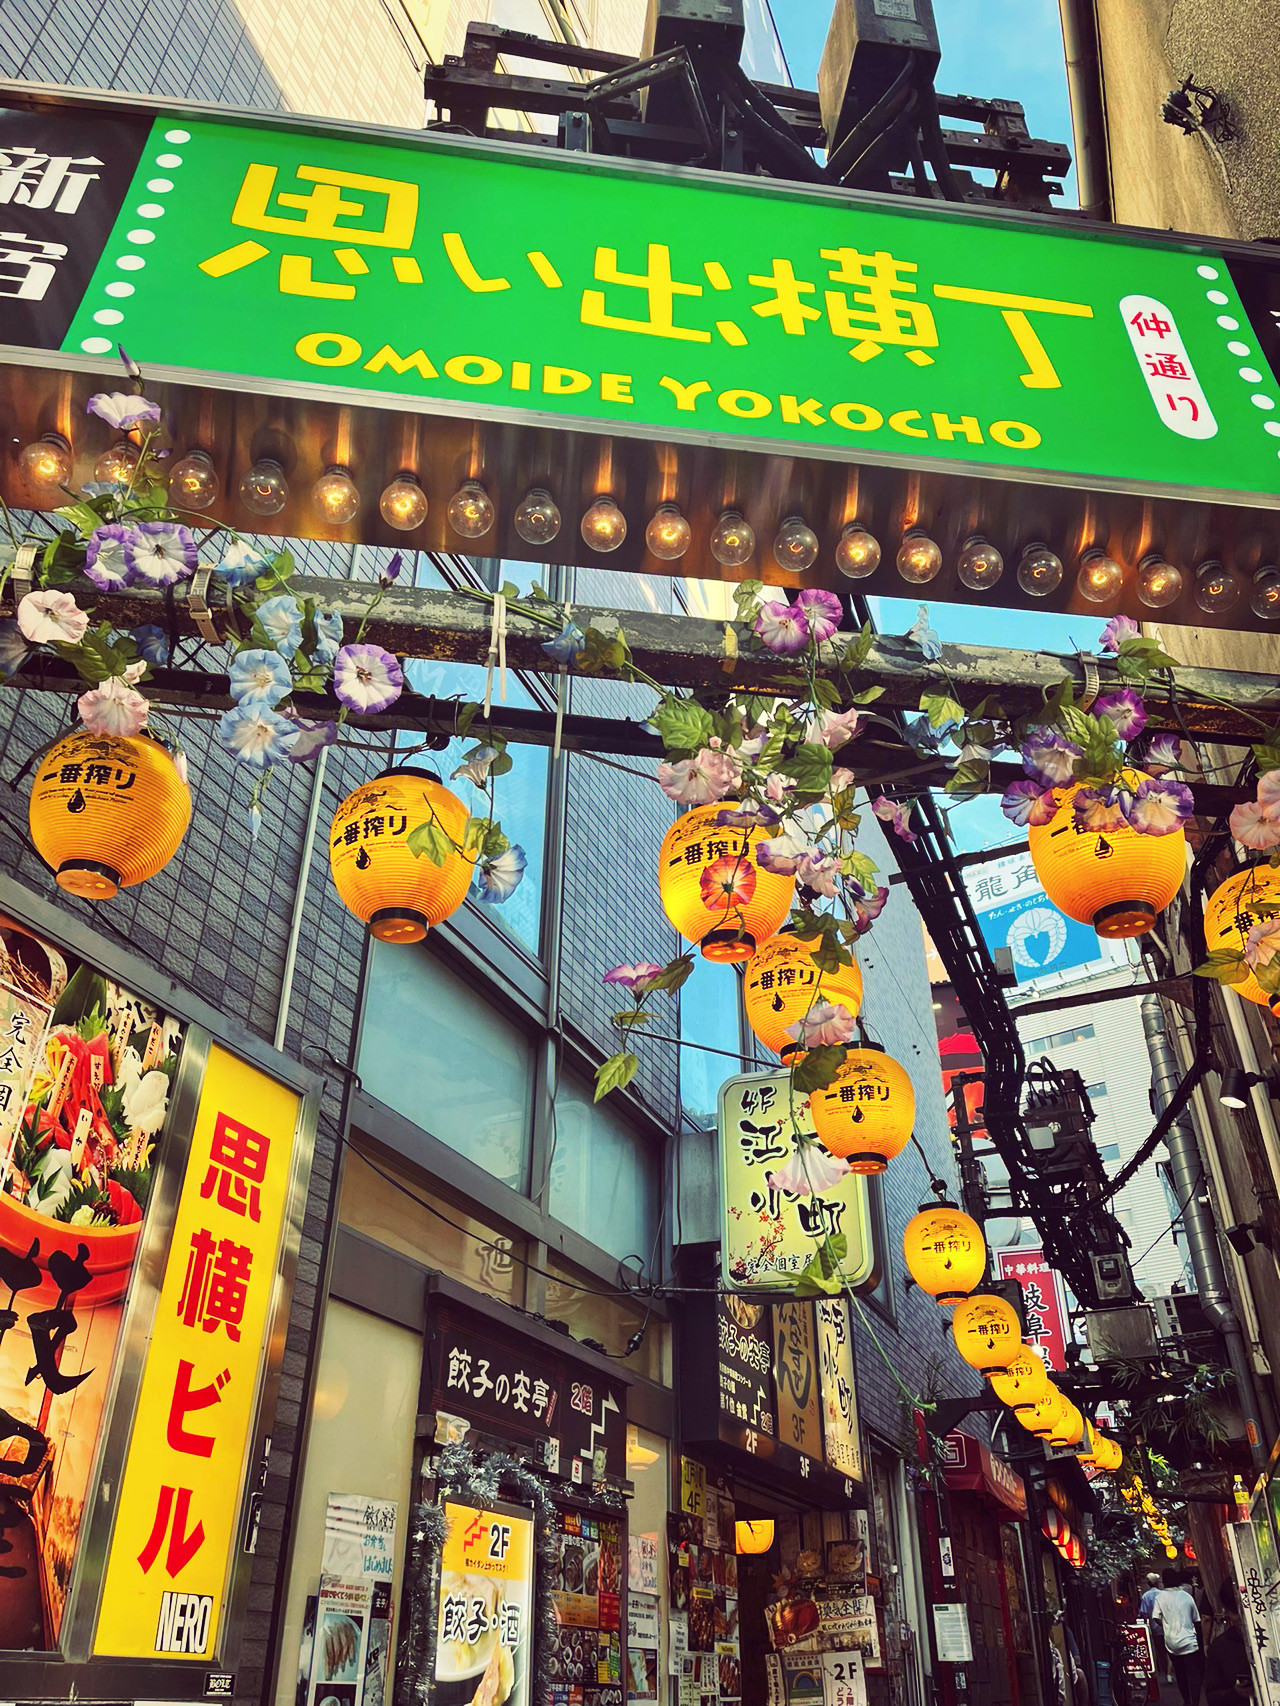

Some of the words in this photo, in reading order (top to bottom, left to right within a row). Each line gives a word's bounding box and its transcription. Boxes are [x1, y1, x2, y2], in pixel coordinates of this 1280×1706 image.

[198, 162, 1094, 390] 思い出横丁
[1130, 309, 1199, 422] 仲通り
[295, 332, 635, 405] OMOIDE
[659, 375, 1043, 450] YOKOCHO
[42, 763, 136, 790] 一番搾り
[333, 815, 407, 848] 一番搾り
[669, 840, 750, 867] 一番搾り
[750, 968, 815, 991] 一番搾り
[825, 1084, 890, 1103] 一番搾り
[922, 1241, 971, 1253] 一番搾り
[1004, 1262, 1051, 1276] 中華料理
[968, 1323, 1010, 1335] 一番搾り
[137, 1110, 271, 1579] 思横ビル
[447, 1346, 550, 1418] 餃子の安亭
[571, 1382, 593, 1416] 2階
[745, 1428, 758, 1453] 2F
[792, 1413, 805, 1445] 3F
[799, 1455, 809, 1478] 3F
[687, 1490, 701, 1513] 4F
[844, 1478, 853, 1498] 4F
[490, 1523, 510, 1558] 2F
[156, 1592, 213, 1654] NERO
[834, 1661, 857, 1681] 2F
